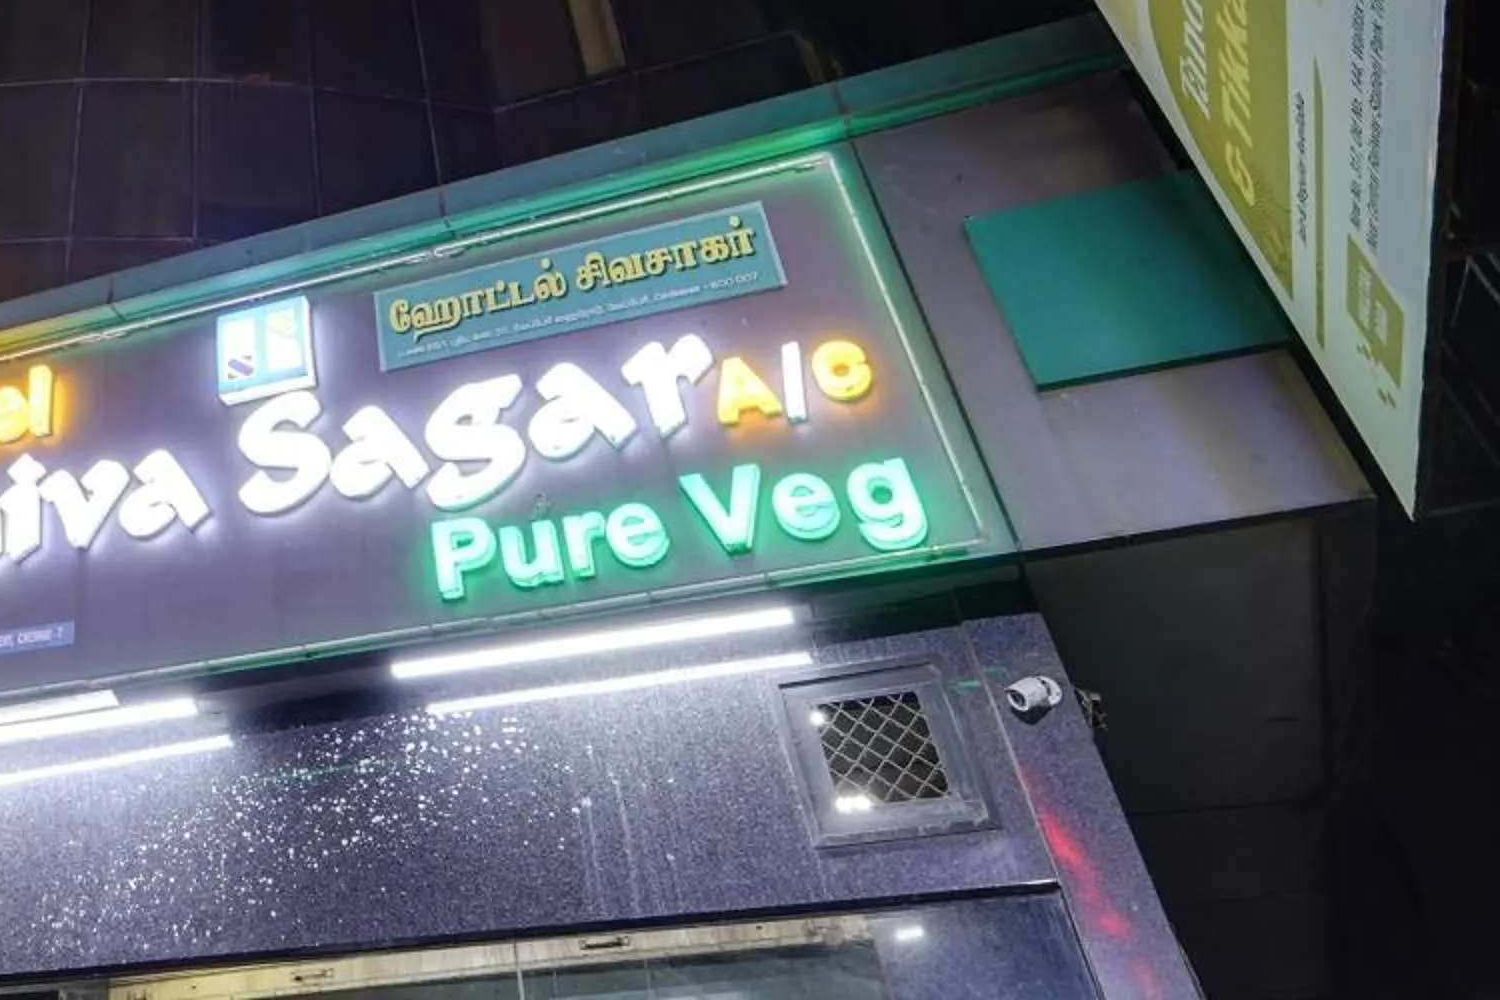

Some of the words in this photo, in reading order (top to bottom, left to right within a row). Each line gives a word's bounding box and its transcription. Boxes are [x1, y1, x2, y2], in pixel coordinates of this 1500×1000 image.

[1225, 141, 1256, 205] &
[237, 333, 714, 515] Sagar
[429, 501, 671, 602] Pure
[680, 456, 930, 553] Veg
